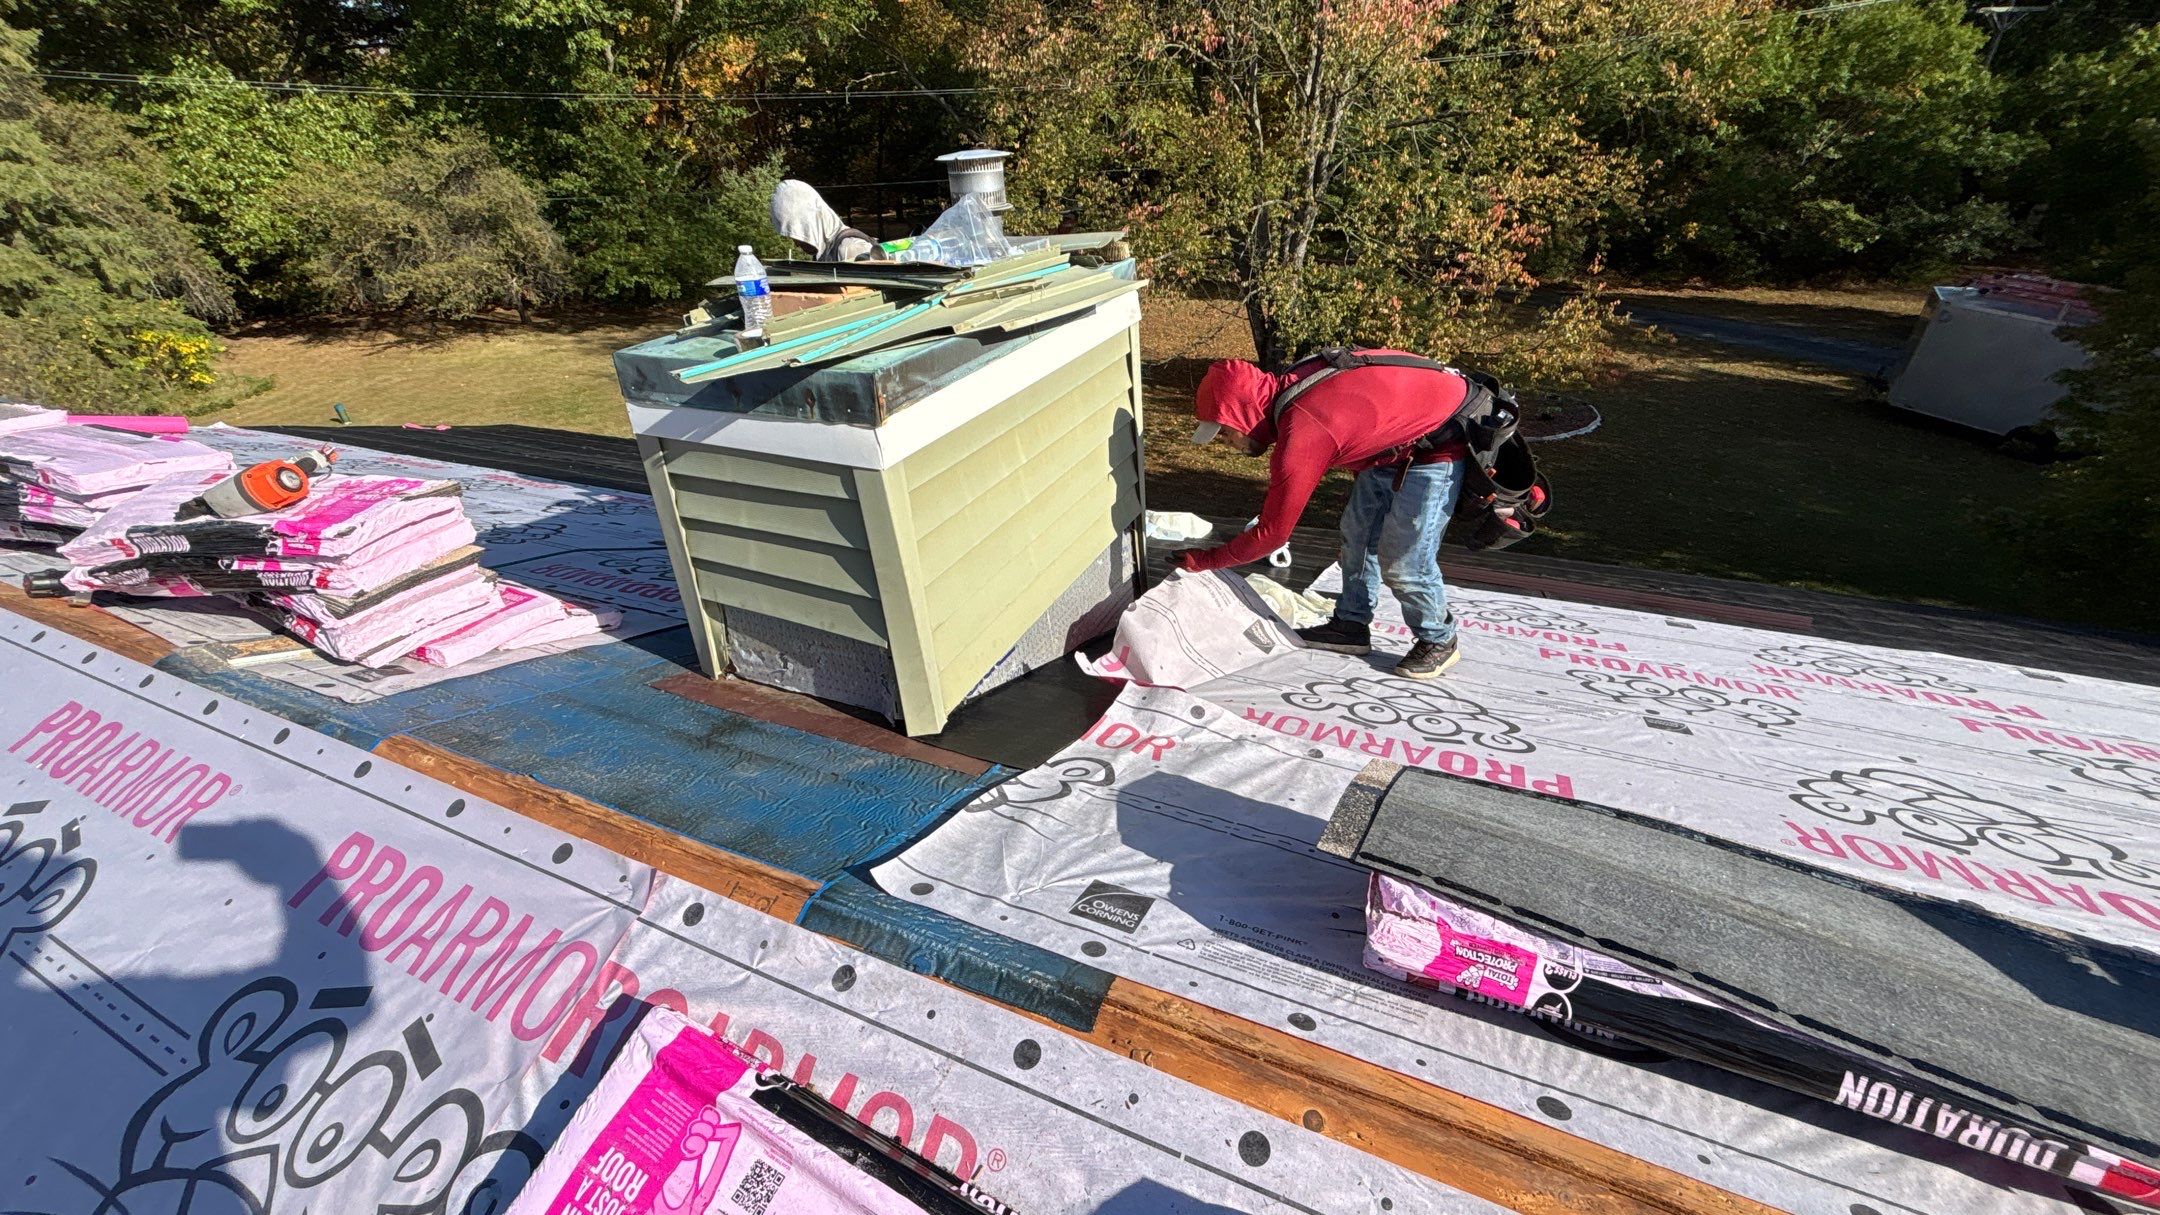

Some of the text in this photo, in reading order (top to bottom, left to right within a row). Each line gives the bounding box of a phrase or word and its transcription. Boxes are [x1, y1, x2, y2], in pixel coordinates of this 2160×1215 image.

[1539, 647, 1799, 700] PROARMOR
[1077, 904, 1136, 928] CORNING
[1092, 900, 1140, 921] OWENS
[1455, 945, 1518, 971] PROTECTION
[1487, 968, 1514, 985] TOTAL
[1554, 964, 1578, 980] CLASS
[1834, 1070, 2069, 1171] DURATION
[590, 1146, 649, 1204] ROOF
